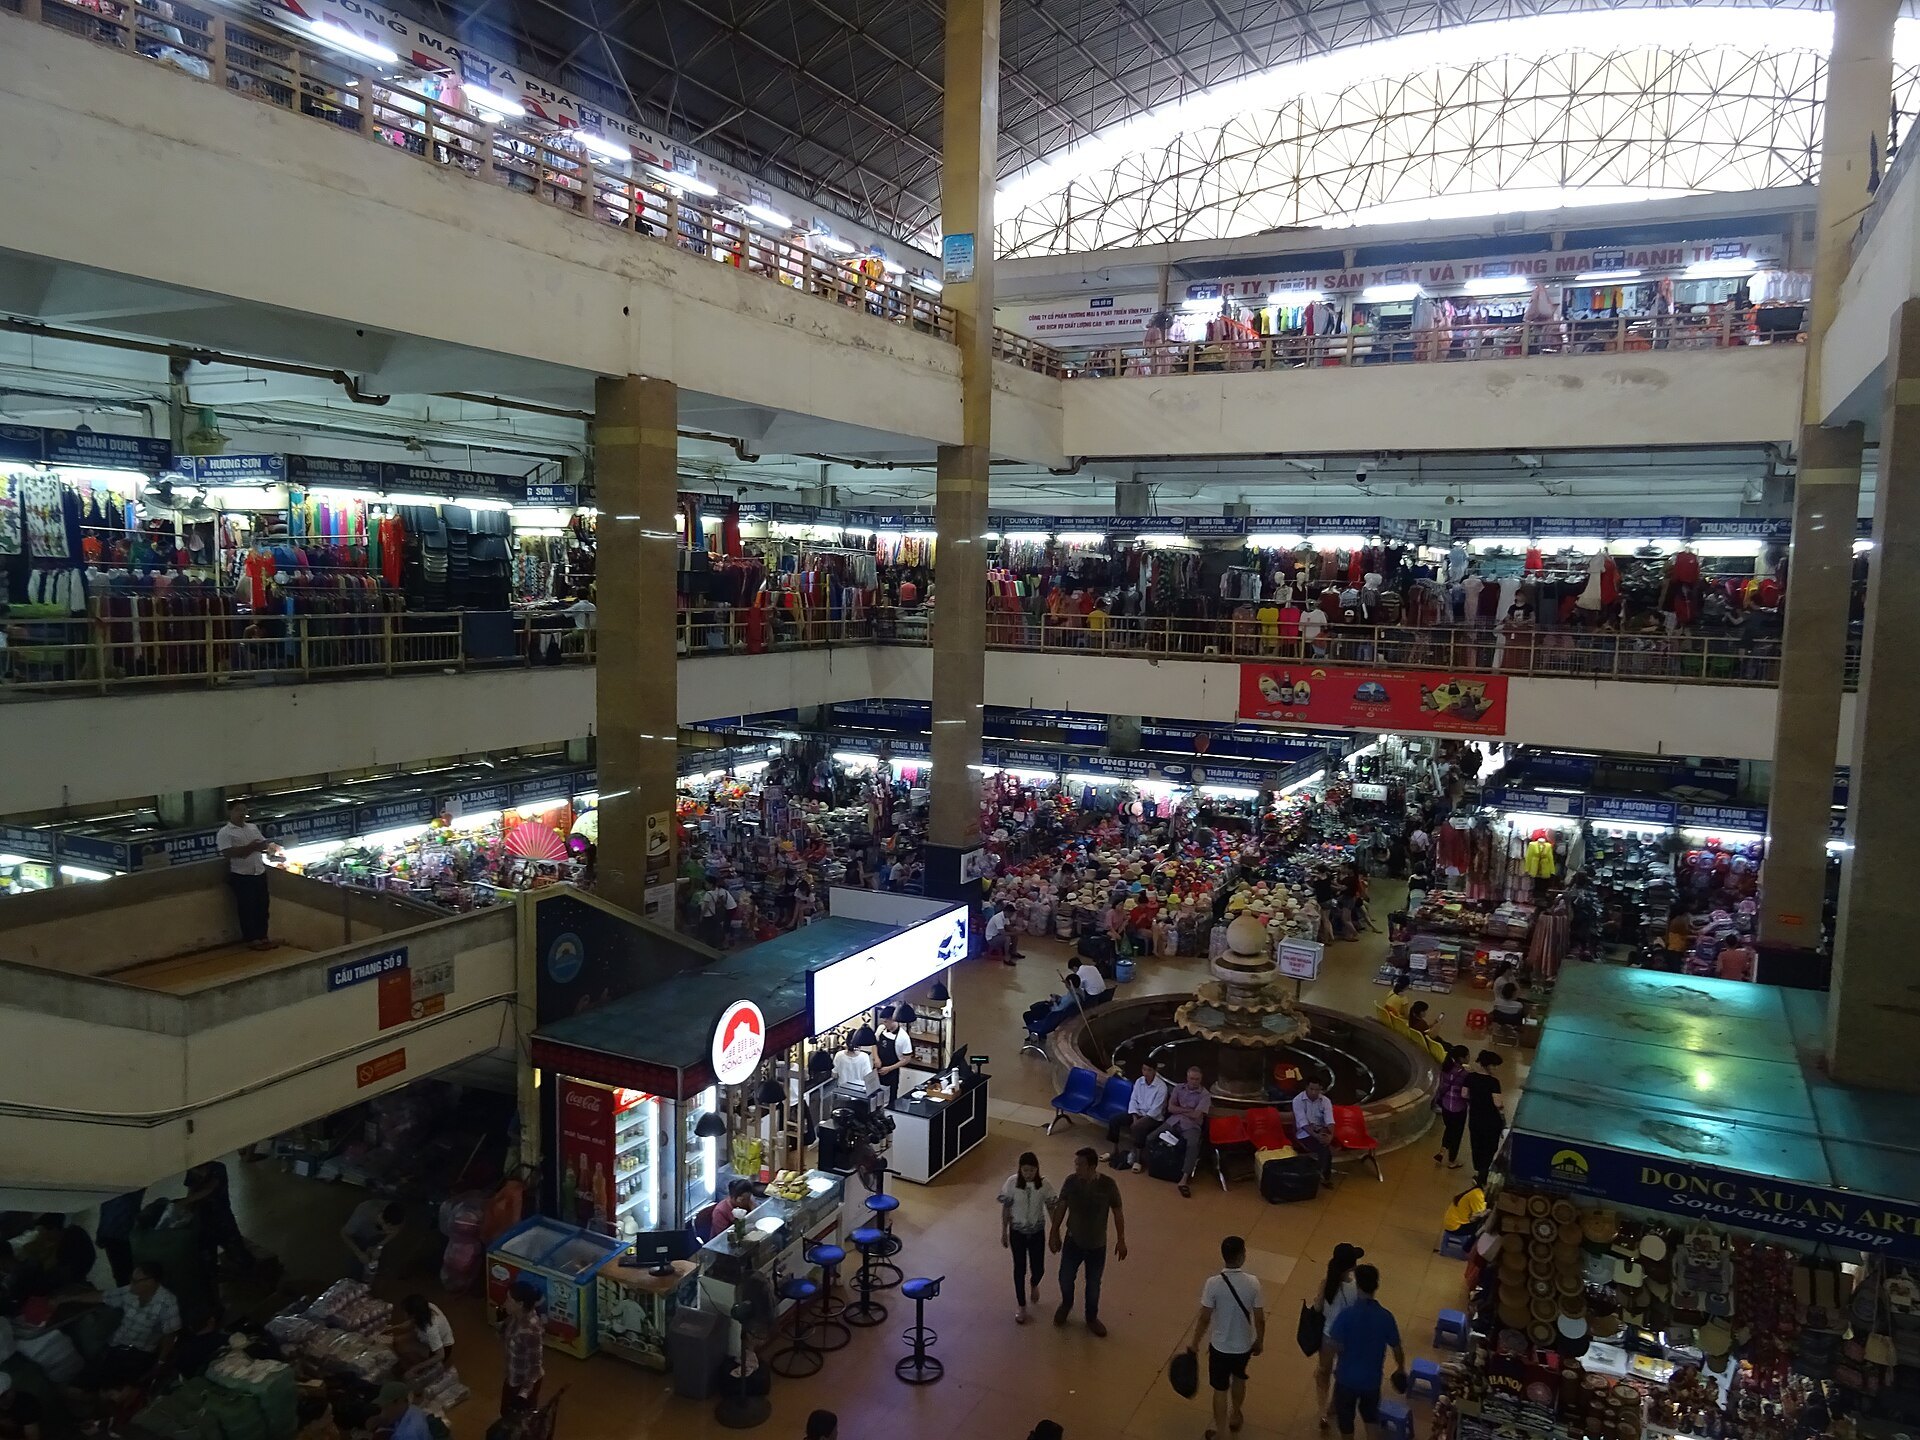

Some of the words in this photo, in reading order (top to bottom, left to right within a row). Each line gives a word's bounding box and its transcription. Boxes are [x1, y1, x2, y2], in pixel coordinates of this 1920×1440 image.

[209, 458, 241, 470] HƯƠNG
[241, 457, 262, 469] SƠN
[1318, 518, 1341, 526] LAN
[1342, 518, 1367, 526] ANH
[1128, 759, 1157, 770] HOA
[1693, 806, 1718, 818] NAM
[1719, 808, 1747, 820] OANH
[335, 966, 353, 986] CẦU
[354, 960, 383, 980] THANG
[383, 953, 395, 971] SỐ
[396, 954, 403, 967] 9
[565, 1090, 602, 1113] Coca-Cola
[1640, 1166, 1737, 1202] DONG
[1748, 1186, 1850, 1223] XUAN
[1668, 1192, 1808, 1231] Souvenirs
[1816, 1221, 1895, 1248] Shop
